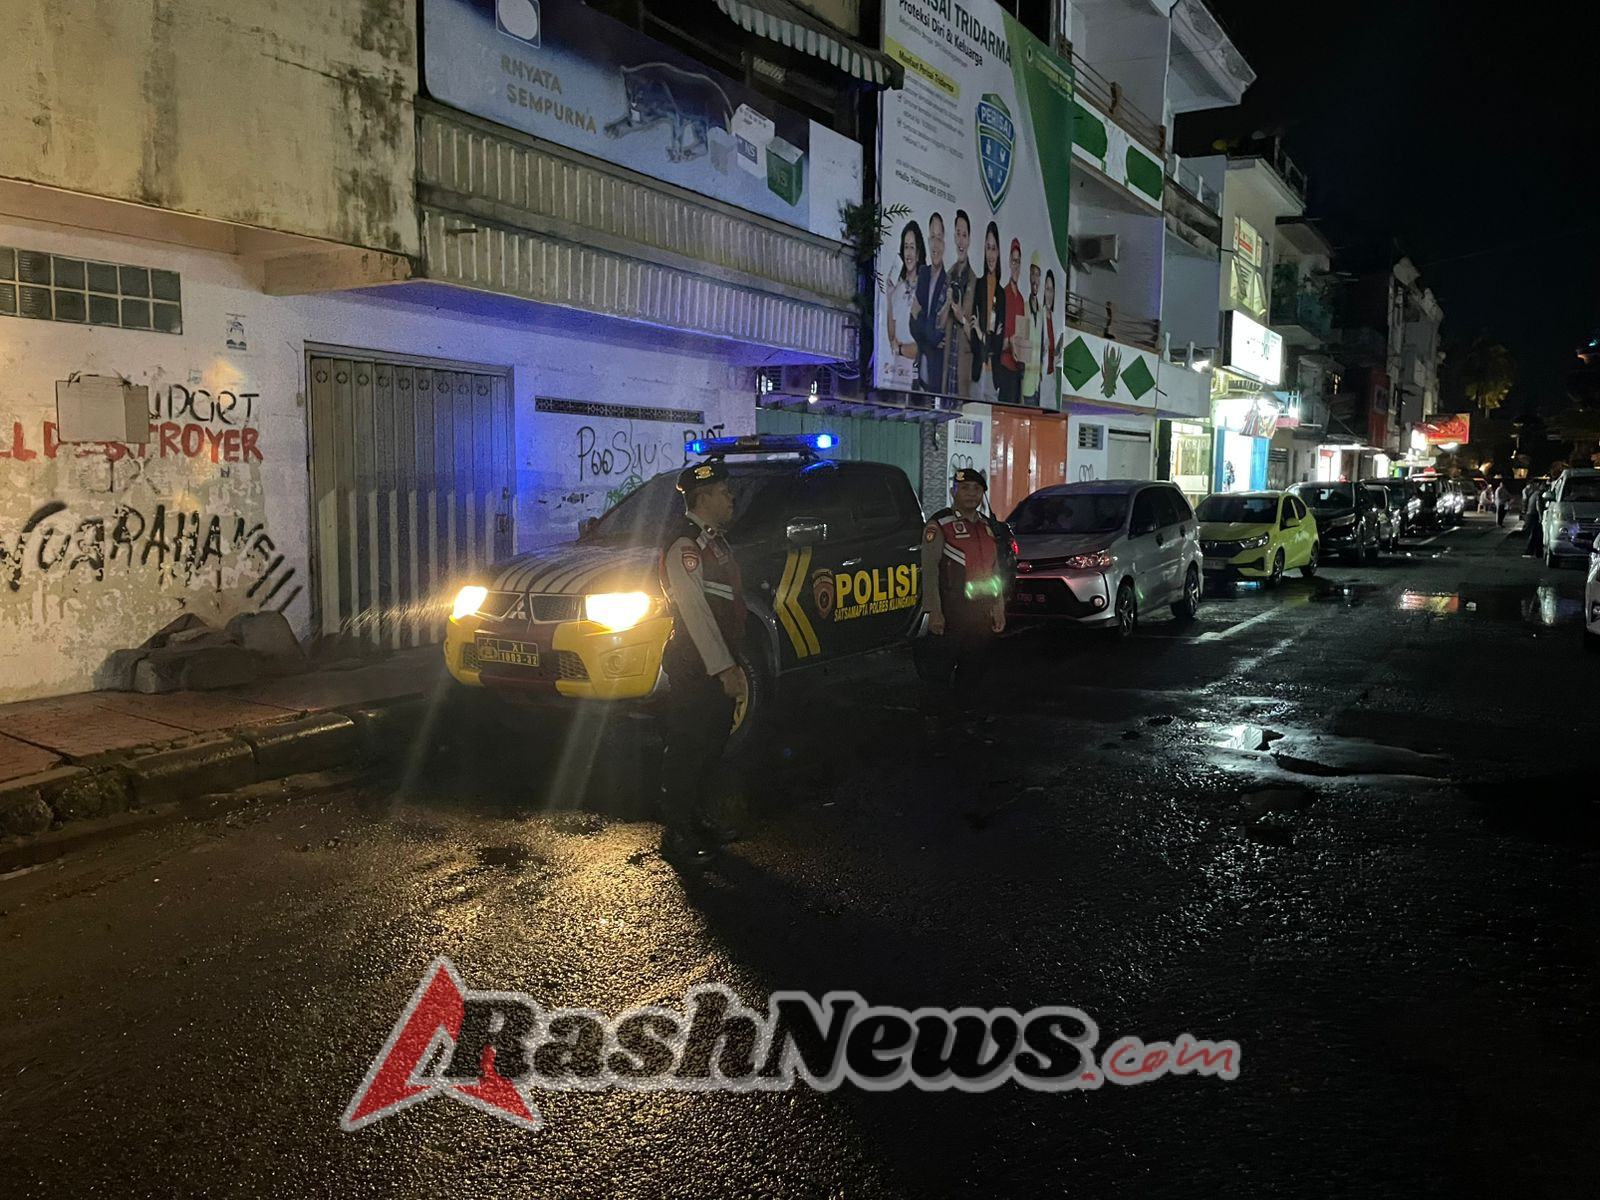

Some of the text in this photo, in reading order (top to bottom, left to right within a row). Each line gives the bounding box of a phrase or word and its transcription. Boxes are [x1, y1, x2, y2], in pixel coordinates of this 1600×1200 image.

[899, 0, 930, 28] Proteksi
[932, 18, 945, 38] Diri
[946, 29, 953, 45] &
[954, 3, 1012, 67] TRIDARMA
[506, 83, 597, 135] SEMPURNA
[981, 106, 1012, 139] PERISAI
[835, 563, 918, 609] POLISI
